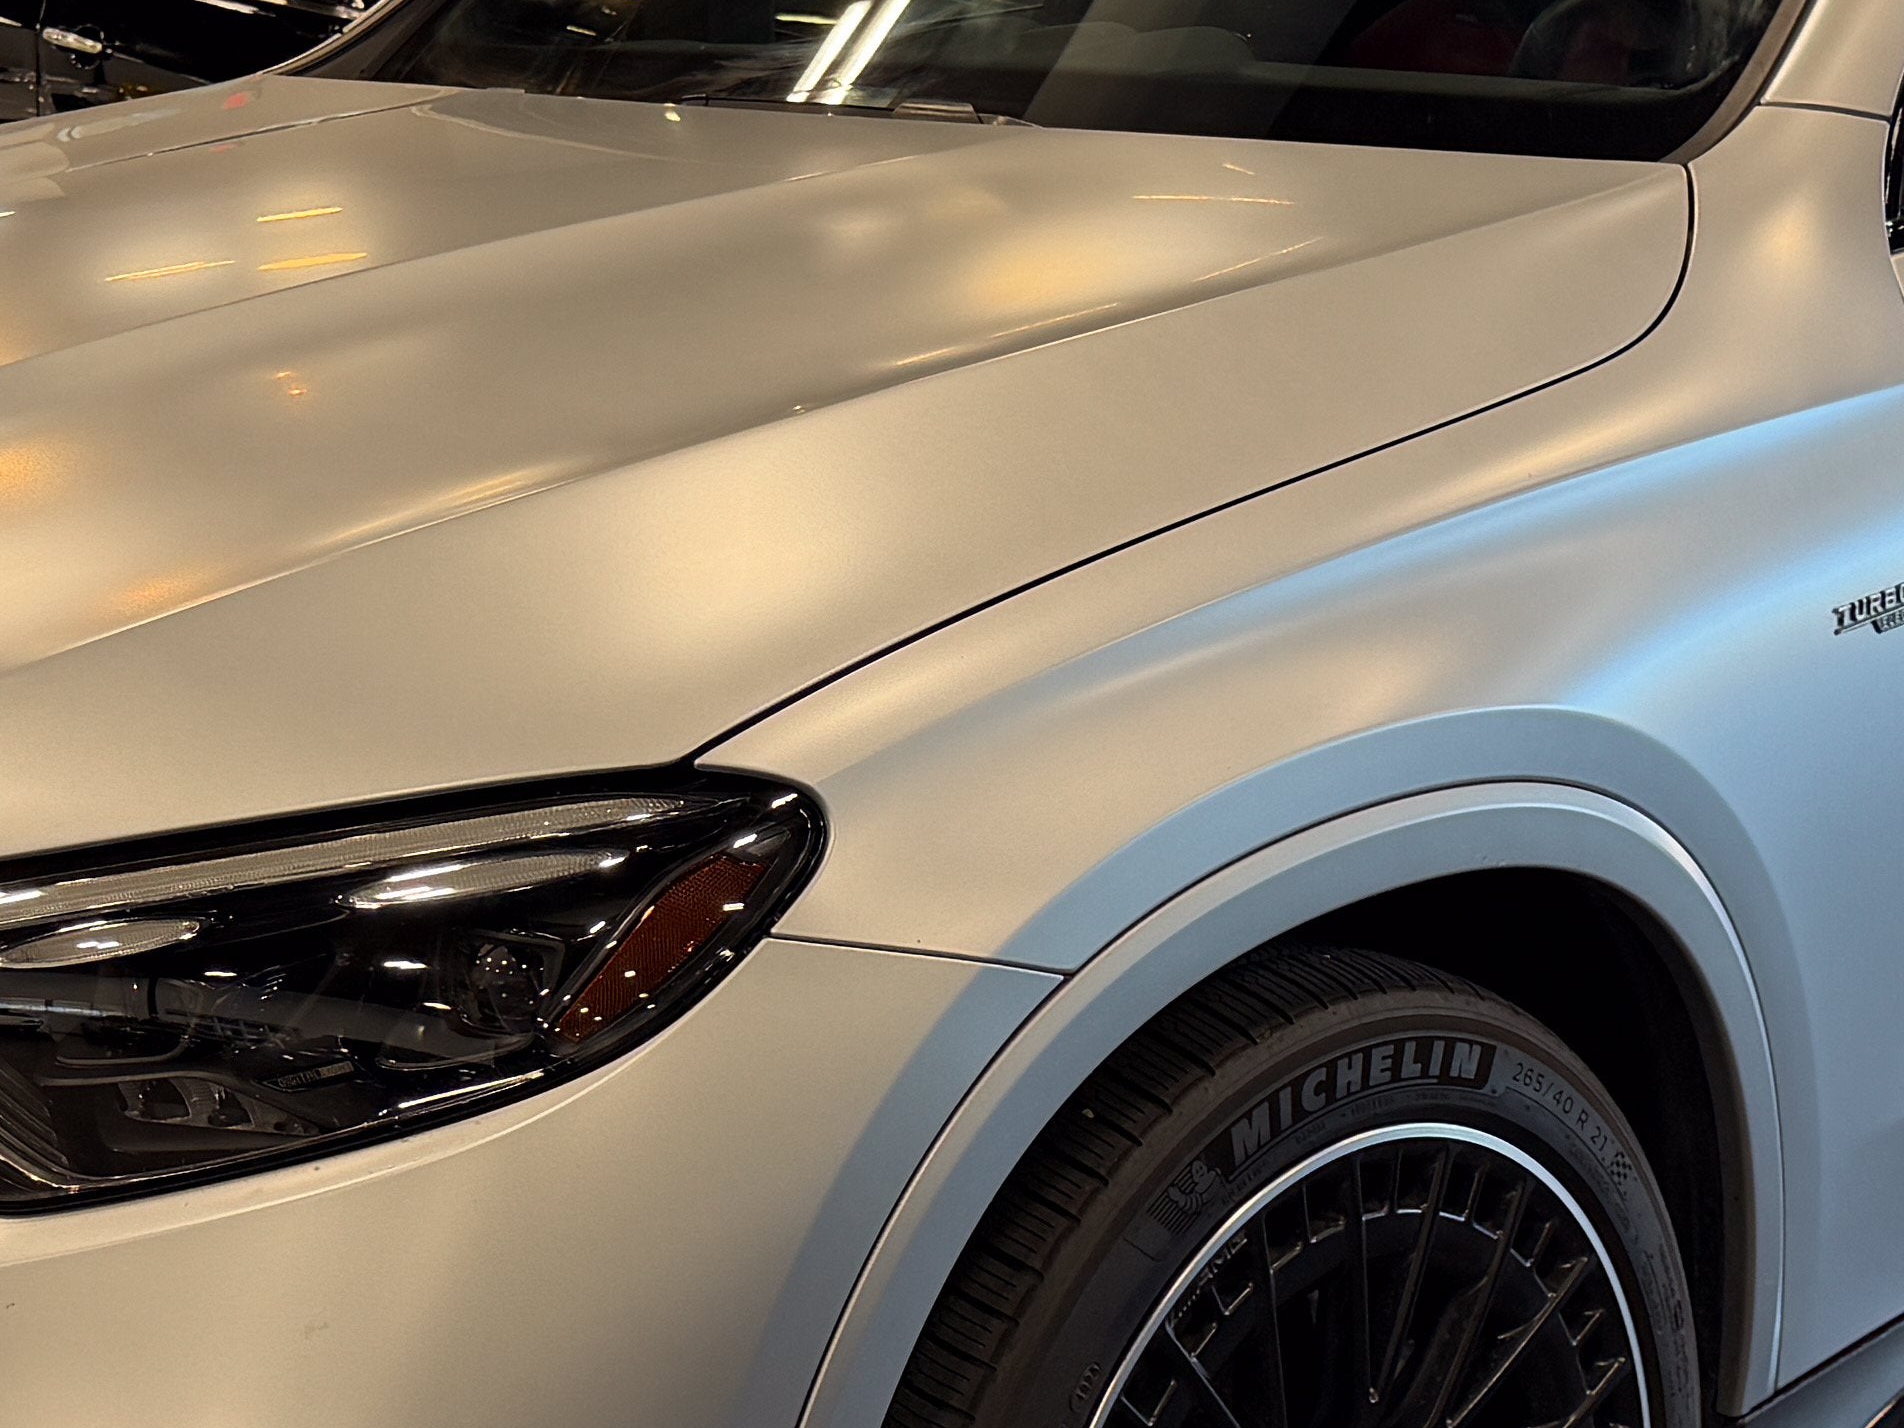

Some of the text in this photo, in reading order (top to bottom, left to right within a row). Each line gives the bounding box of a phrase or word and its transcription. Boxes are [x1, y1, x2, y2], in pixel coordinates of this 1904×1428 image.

[1229, 1039, 1483, 1175] MICHELIN
[1511, 1061, 1609, 1152] 265/40 R 21
